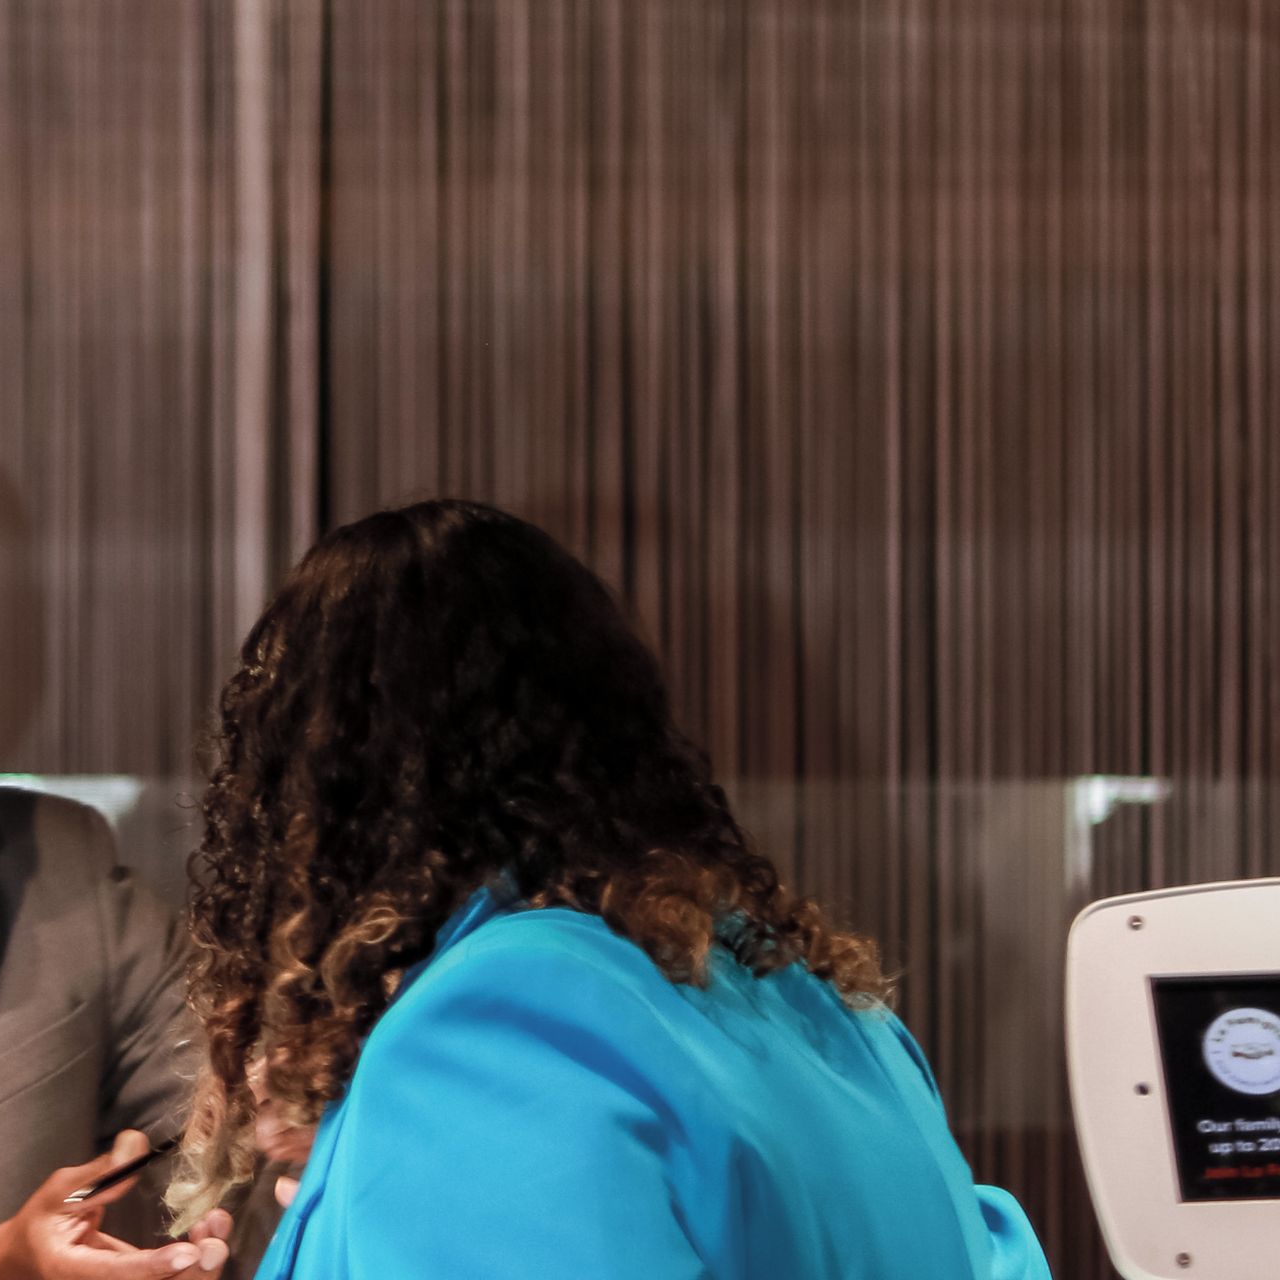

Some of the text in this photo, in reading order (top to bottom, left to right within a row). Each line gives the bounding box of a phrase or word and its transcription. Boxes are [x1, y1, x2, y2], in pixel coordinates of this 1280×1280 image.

[1197, 1119, 1232, 1133] Our
[1209, 1142, 1233, 1155] up
[1235, 1140, 1257, 1152] to
